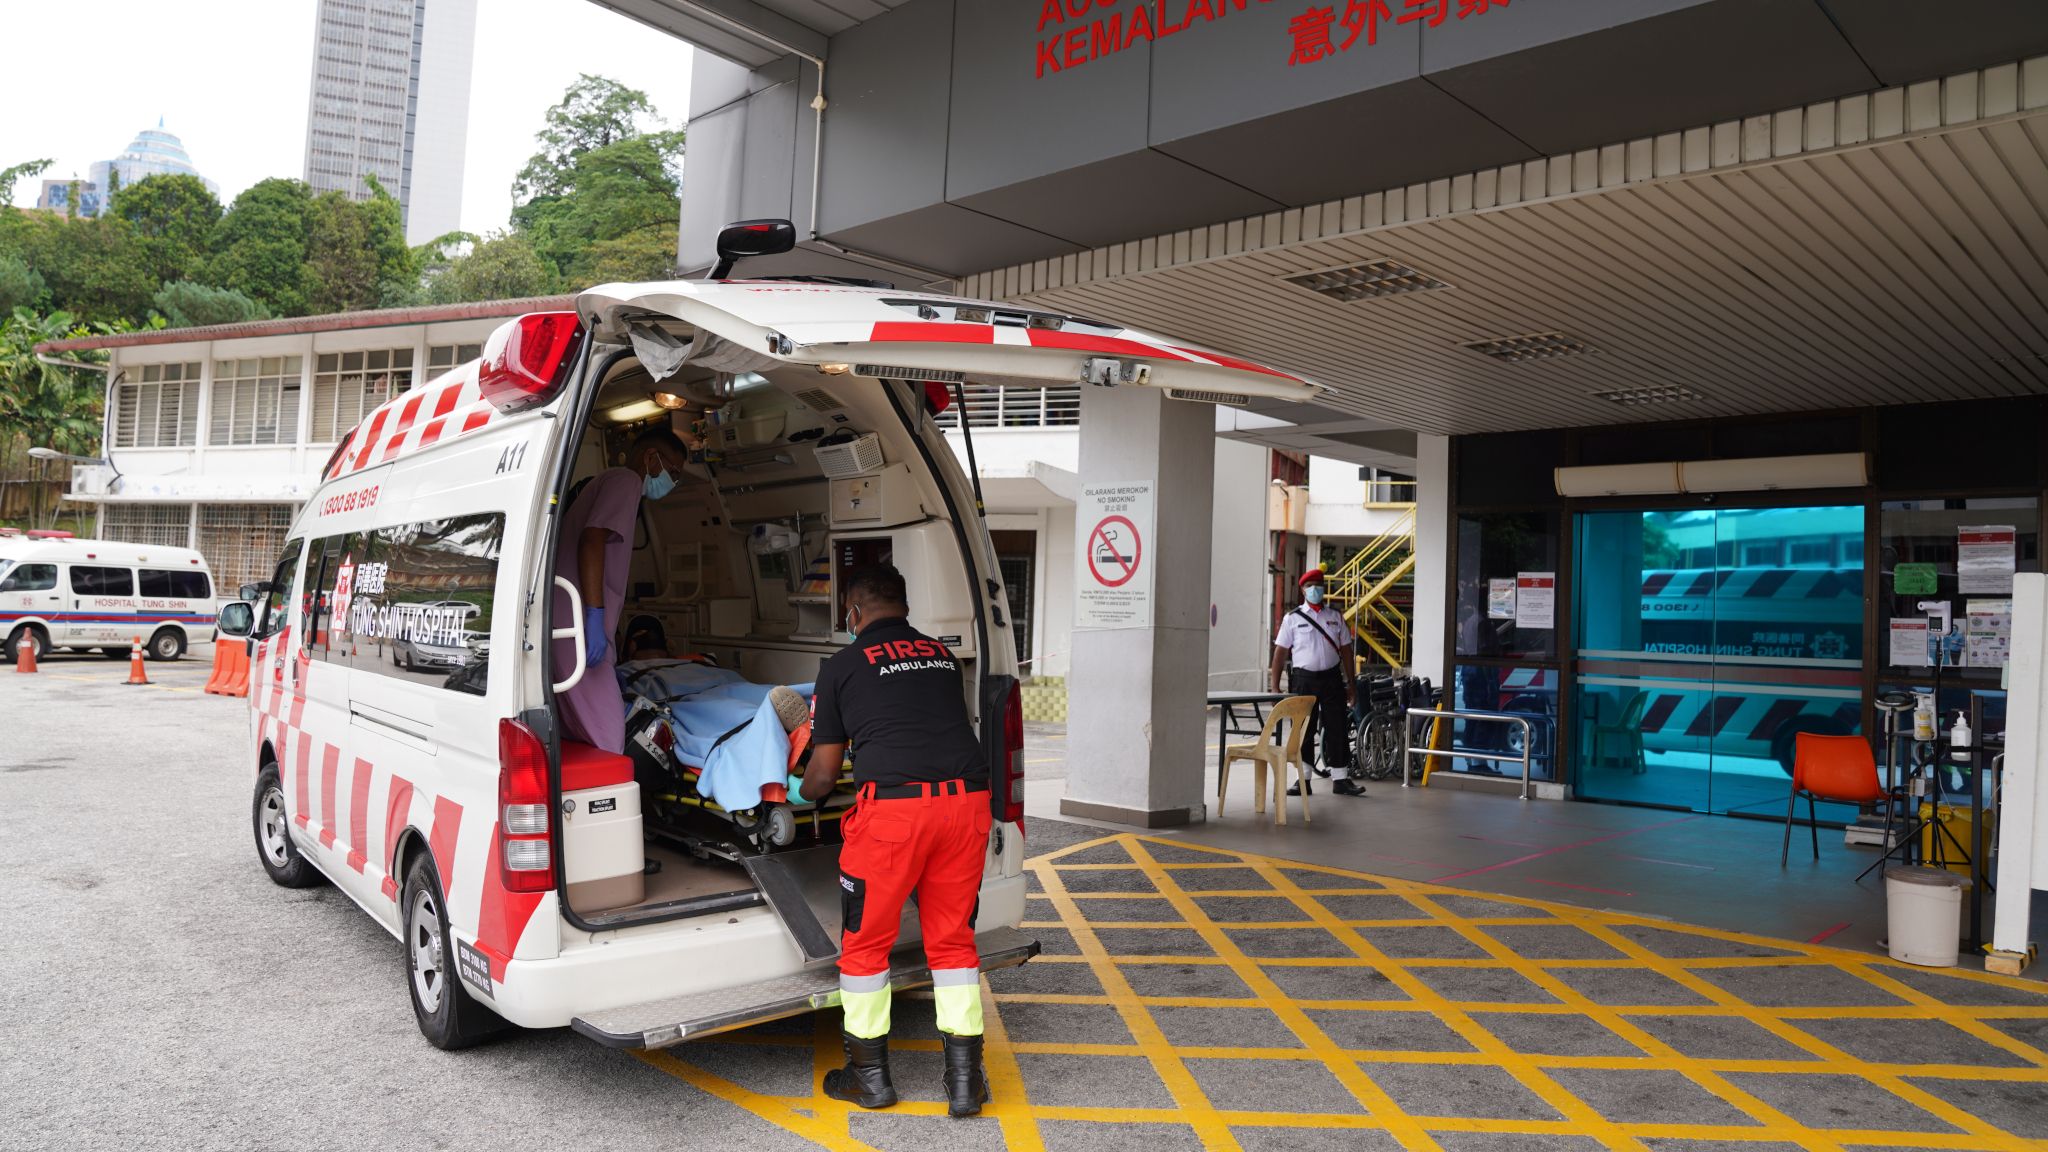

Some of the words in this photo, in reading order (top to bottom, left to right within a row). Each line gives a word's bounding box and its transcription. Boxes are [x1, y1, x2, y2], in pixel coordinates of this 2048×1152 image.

[1035, 0, 1274, 79] KEMALA
[1287, 0, 1513, 67] 意外与
[495, 440, 529, 475] A11
[323, 493, 344, 517] 1300
[344, 489, 358, 512] 88
[357, 485, 379, 509] 1919
[1085, 487, 1116, 496] DILARANG
[1107, 495, 1136, 503] SMOKING
[94, 598, 137, 607] HOSPITAL
[142, 599, 165, 608] TUNG
[169, 600, 187, 608] SHIN
[351, 604, 377, 637] TUNG
[377, 605, 404, 640] SHIN
[404, 607, 468, 648] HOSPITAL
[863, 640, 949, 665] FIRST
[879, 660, 956, 676] AMBULANCE
